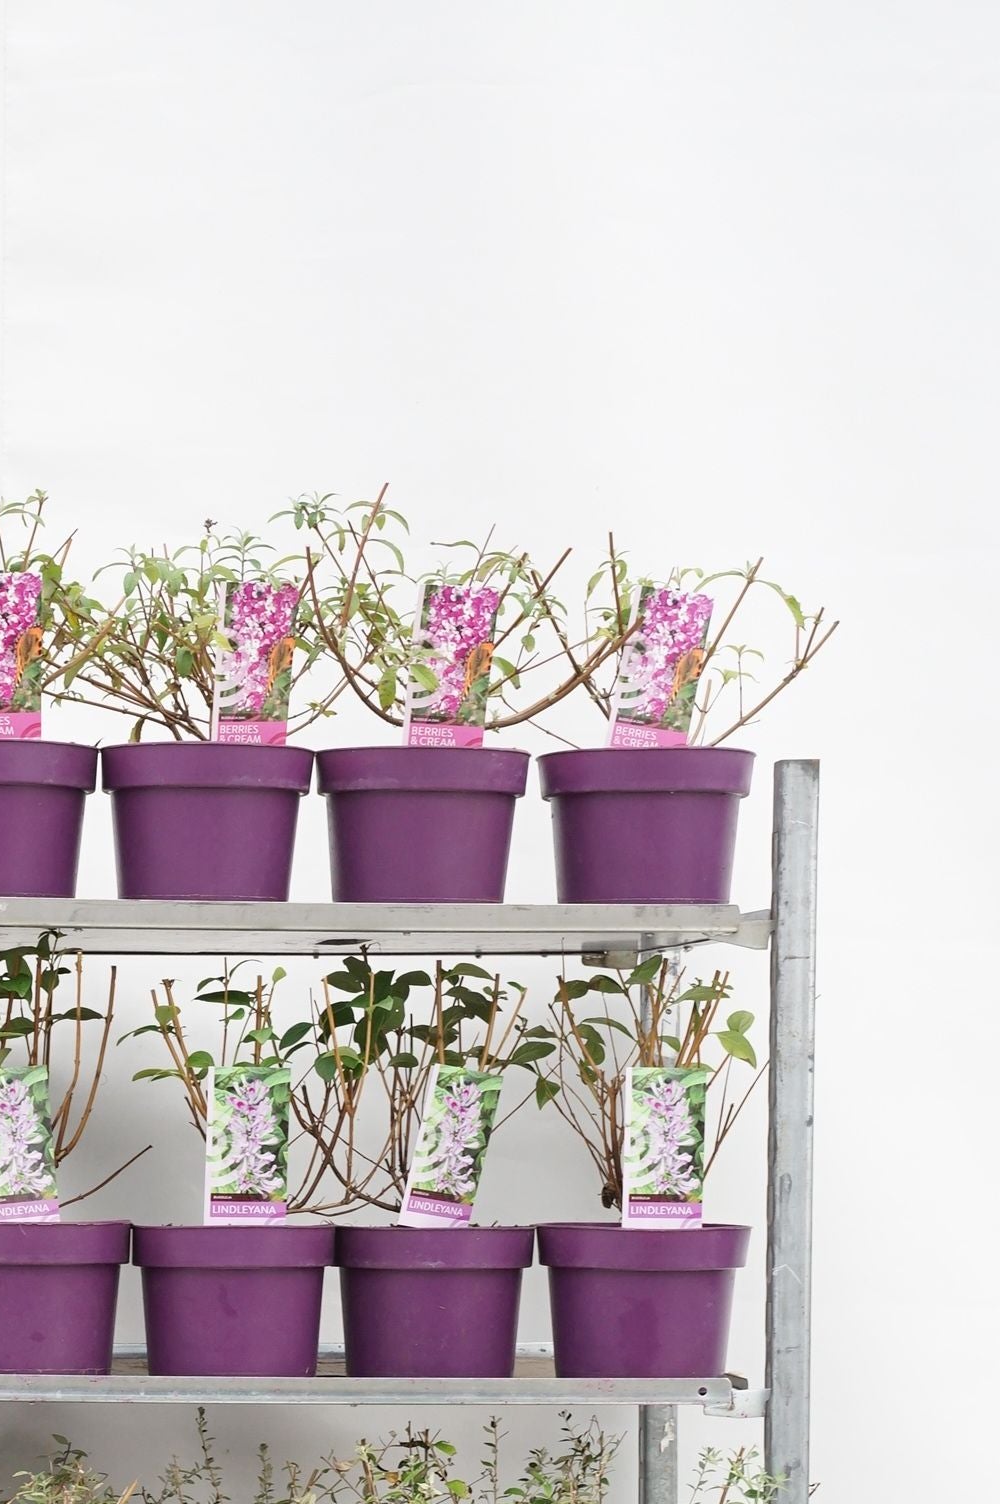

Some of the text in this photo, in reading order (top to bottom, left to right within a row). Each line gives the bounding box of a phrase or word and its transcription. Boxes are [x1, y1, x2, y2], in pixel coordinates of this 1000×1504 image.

[219, 724, 260, 735] BERRIES
[410, 726, 454, 737] BERRIES
[615, 725, 657, 740] BERRIES
[228, 734, 262, 744] CREAM
[419, 737, 457, 747] CREAM
[211, 1204, 277, 1215] LINDLEYANA
[409, 1199, 464, 1217] LINDLEYANA
[630, 1205, 693, 1216] LINDLEYANA
